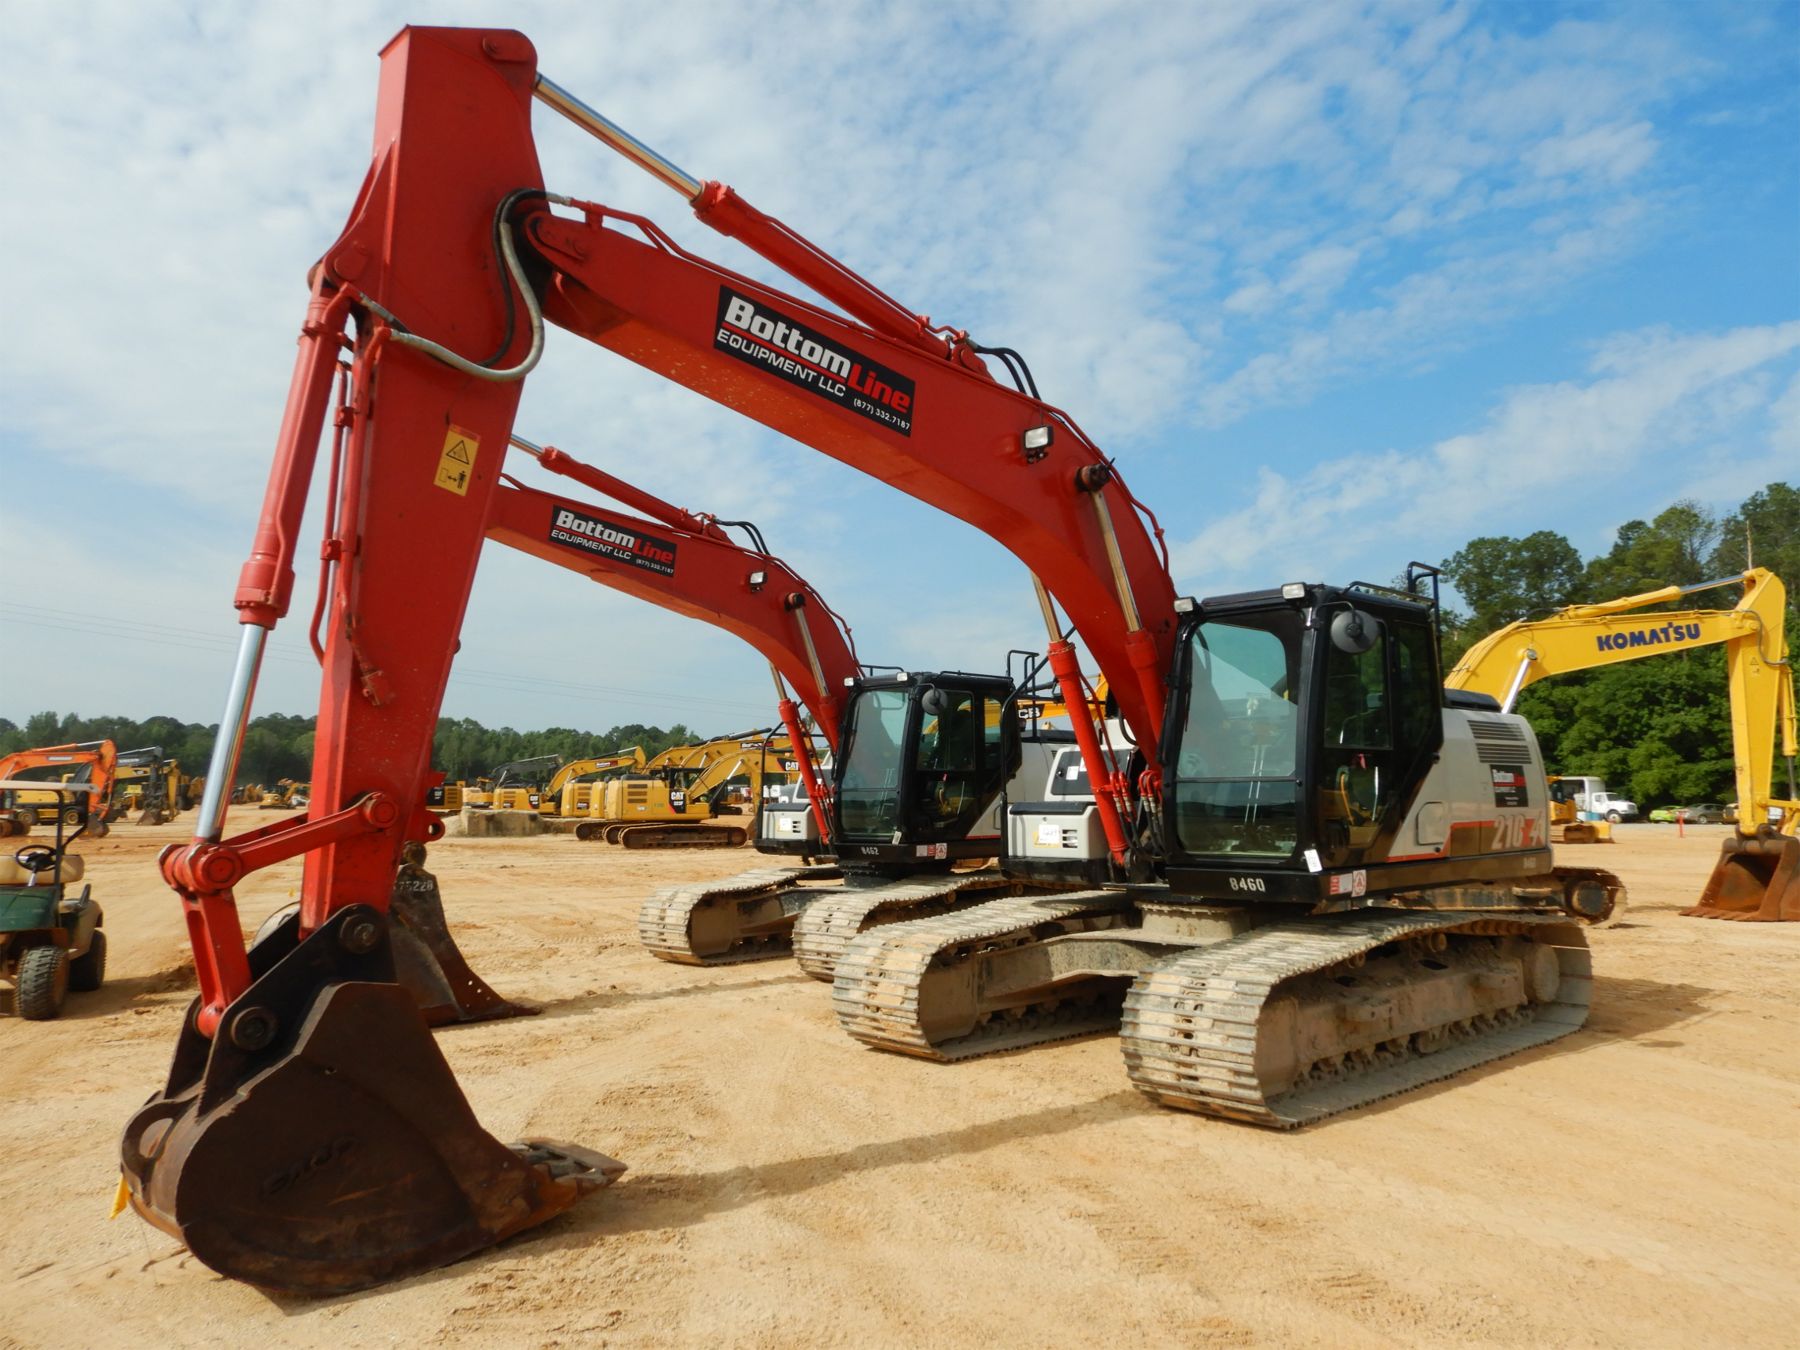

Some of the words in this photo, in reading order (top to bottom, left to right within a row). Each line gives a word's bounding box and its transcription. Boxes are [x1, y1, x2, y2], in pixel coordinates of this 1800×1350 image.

[717, 328, 818, 382] EQUIPMENT
[818, 377, 846, 397] LLC
[853, 398, 874, 415] (877)
[875, 408, 911, 430] 332.7187
[551, 529, 613, 553] EQUIPMENT
[613, 549, 632, 560] LLC
[1596, 622, 1701, 651] KOMATSU
[1018, 707, 1041, 719] CB
[785, 761, 799, 771] CAT
[671, 791, 685, 801] CAT
[1229, 877, 1266, 892] 8460
